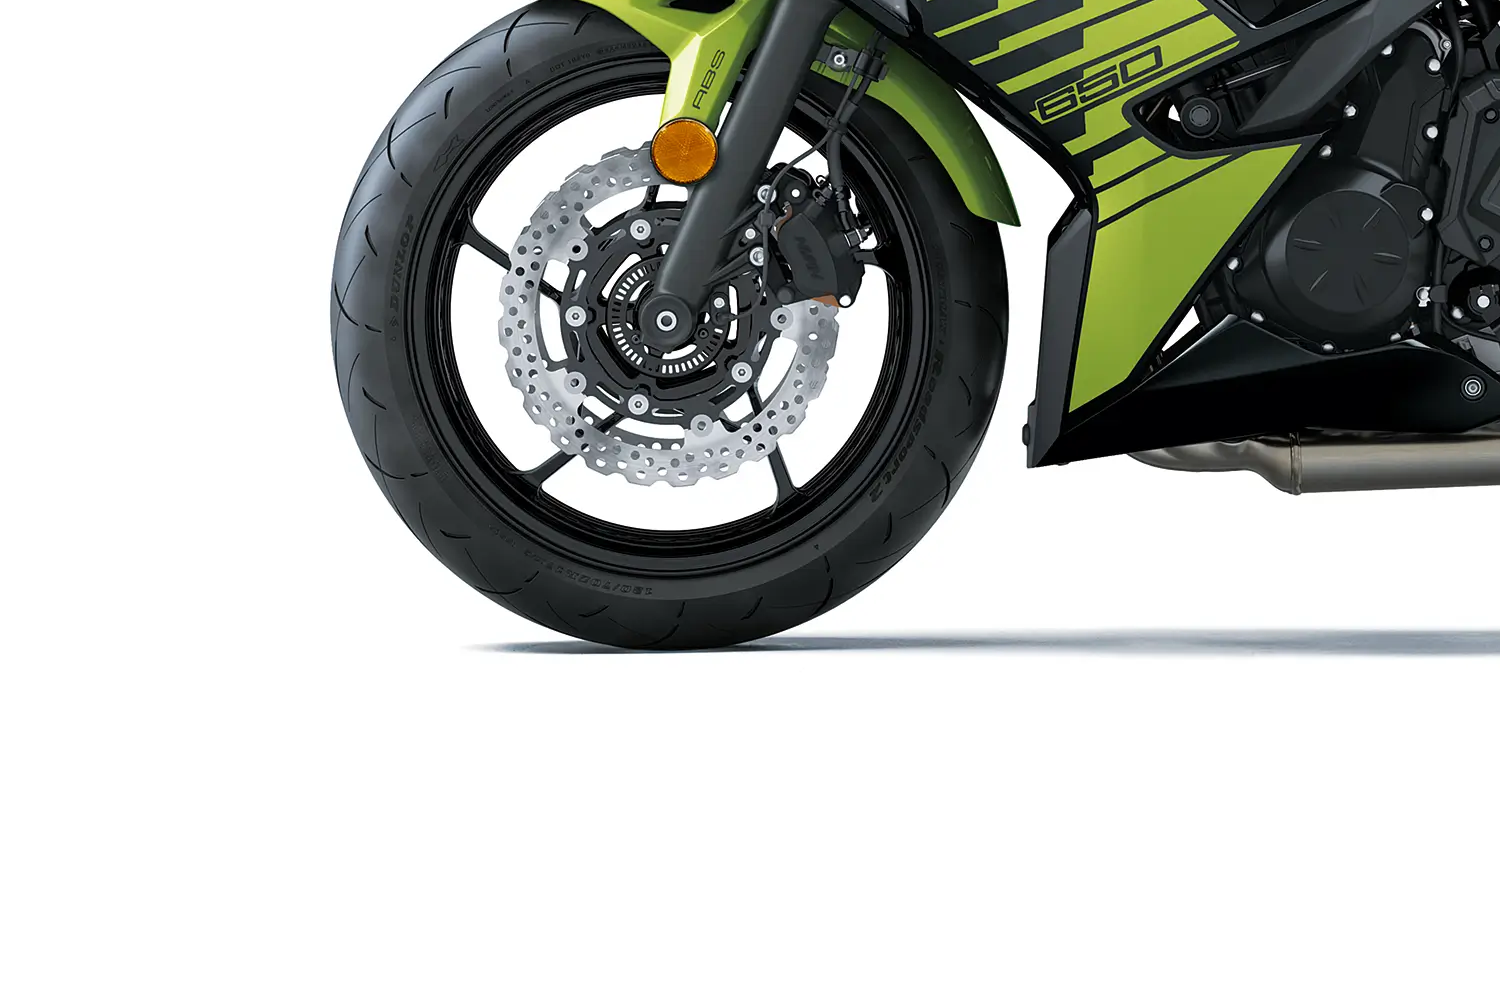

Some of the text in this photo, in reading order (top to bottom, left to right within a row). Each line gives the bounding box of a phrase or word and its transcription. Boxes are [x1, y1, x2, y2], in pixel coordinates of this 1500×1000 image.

[691, 48, 727, 111] ABS
[1036, 45, 1164, 122] 650
[390, 213, 418, 313] DUNLOP
[884, 351, 944, 485] Roadsport
[867, 483, 885, 505] 2
